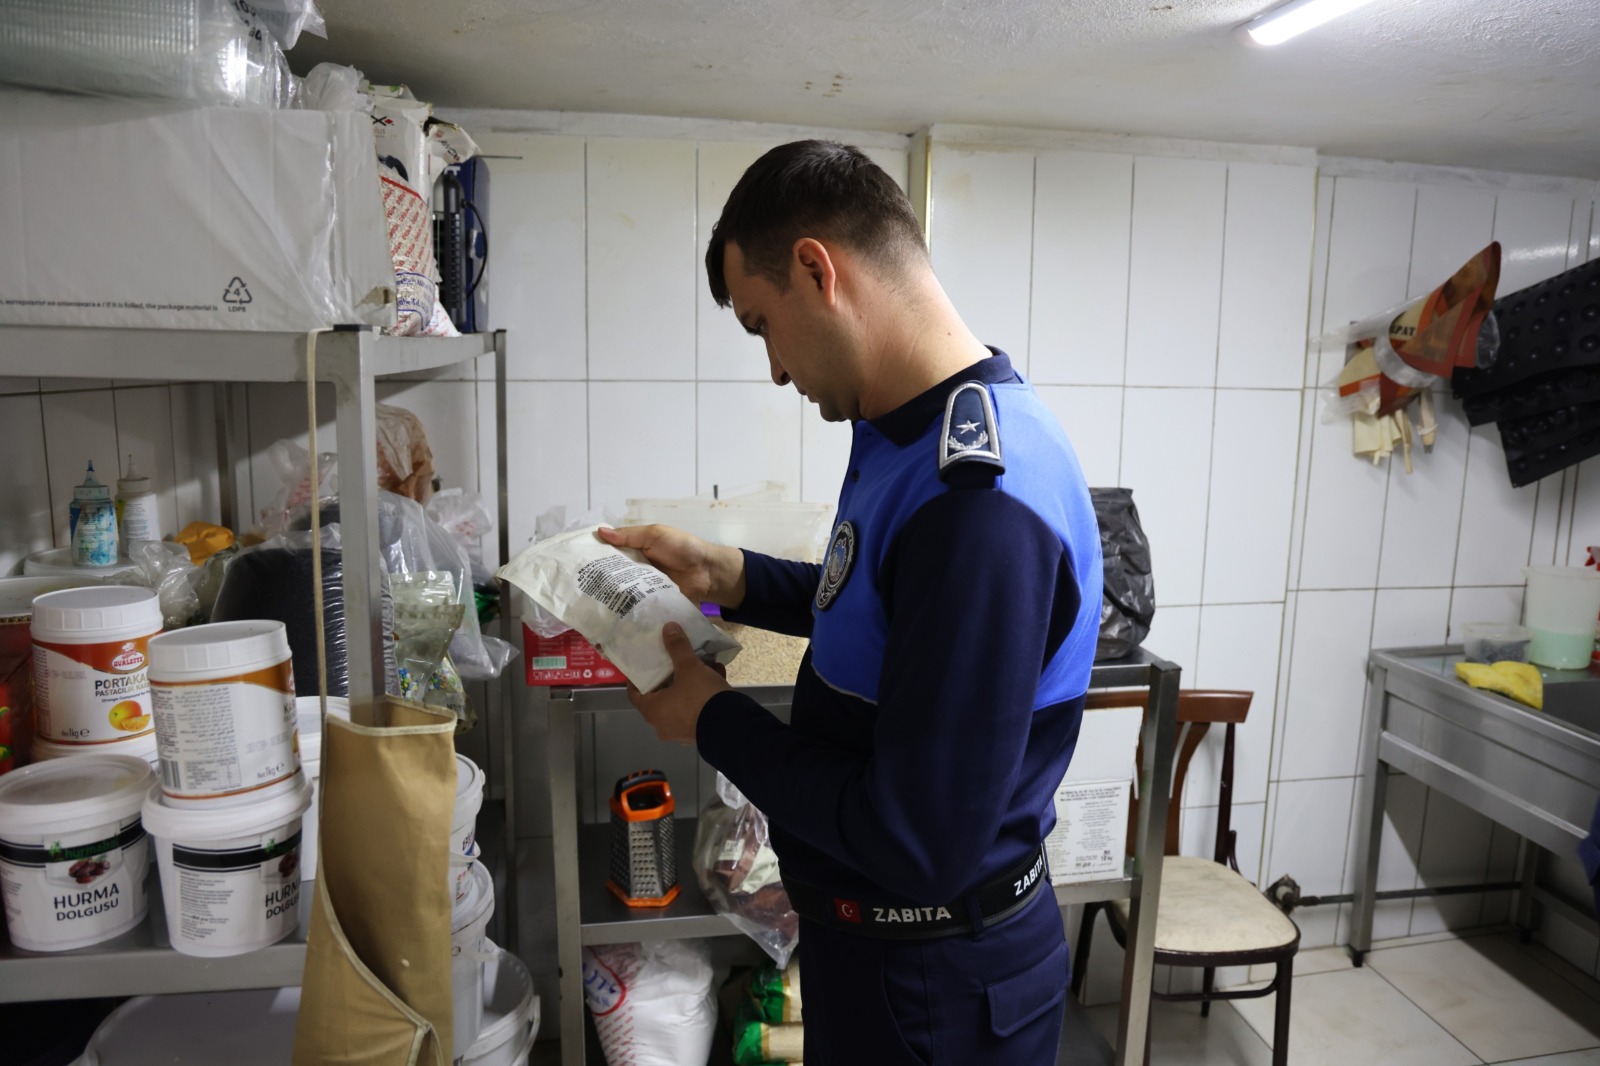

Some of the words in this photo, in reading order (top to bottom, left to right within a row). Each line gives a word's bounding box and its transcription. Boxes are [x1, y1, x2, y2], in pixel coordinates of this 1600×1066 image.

[54, 882, 120, 909] HURMA
[265, 880, 300, 908] HURM
[56, 898, 119, 921] DOLGUSU
[872, 905, 952, 923] ZABITA
